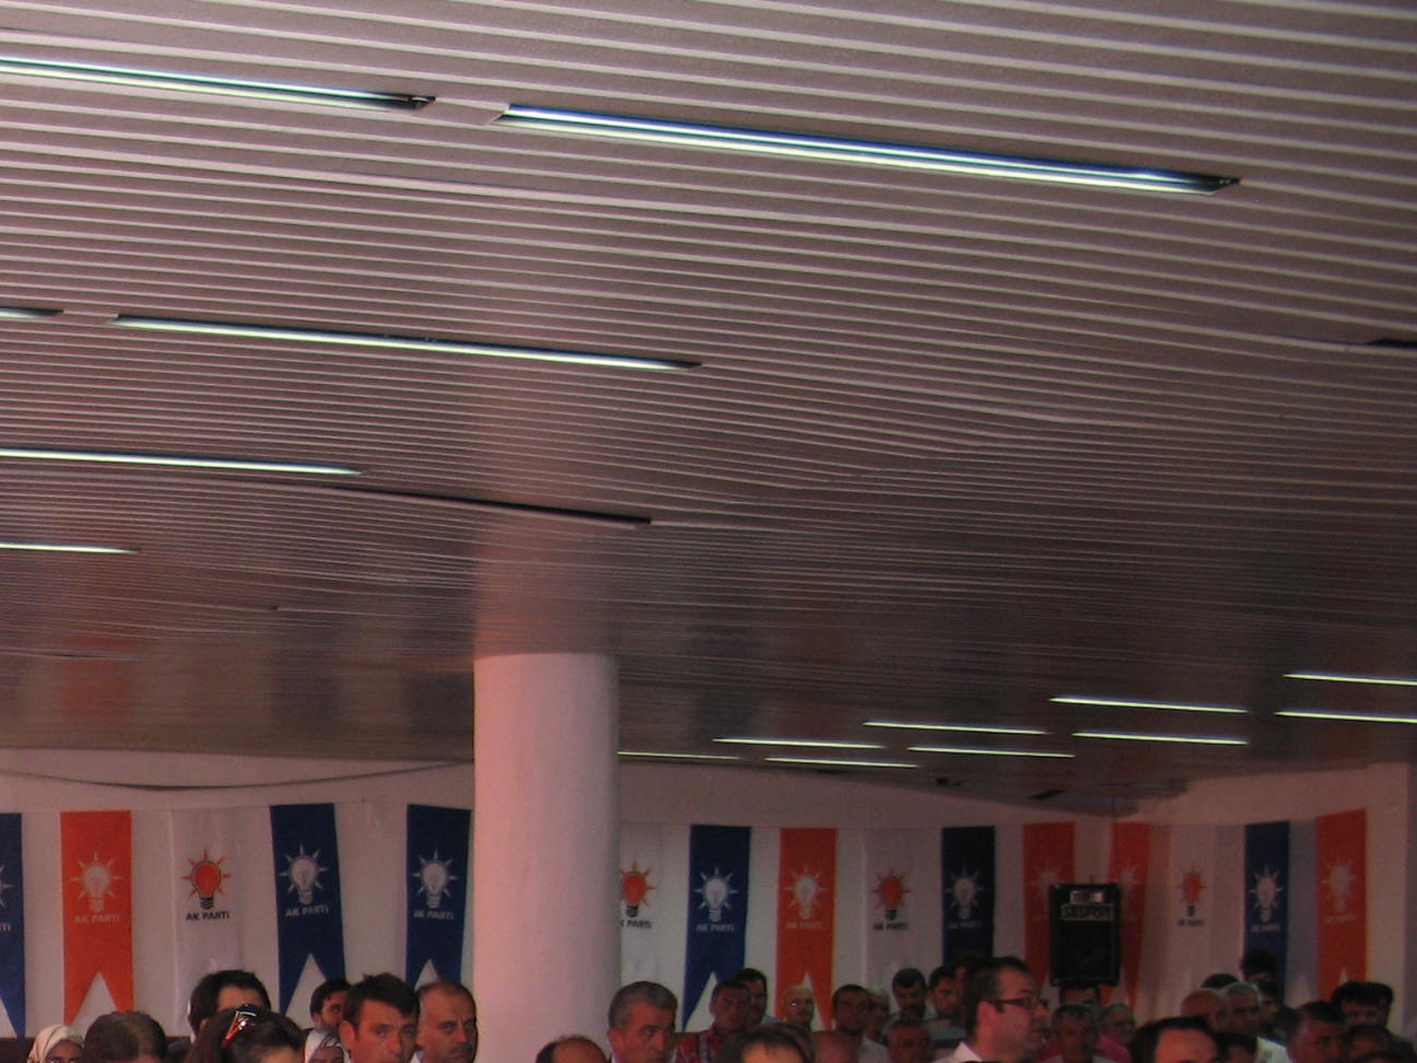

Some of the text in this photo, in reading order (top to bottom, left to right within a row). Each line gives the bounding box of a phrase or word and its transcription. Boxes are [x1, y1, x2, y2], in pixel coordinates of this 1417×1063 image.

[185, 912, 199, 921] AK
[285, 908, 300, 918] AK
[413, 910, 426, 919] AK
[74, 914, 89, 924] AK
